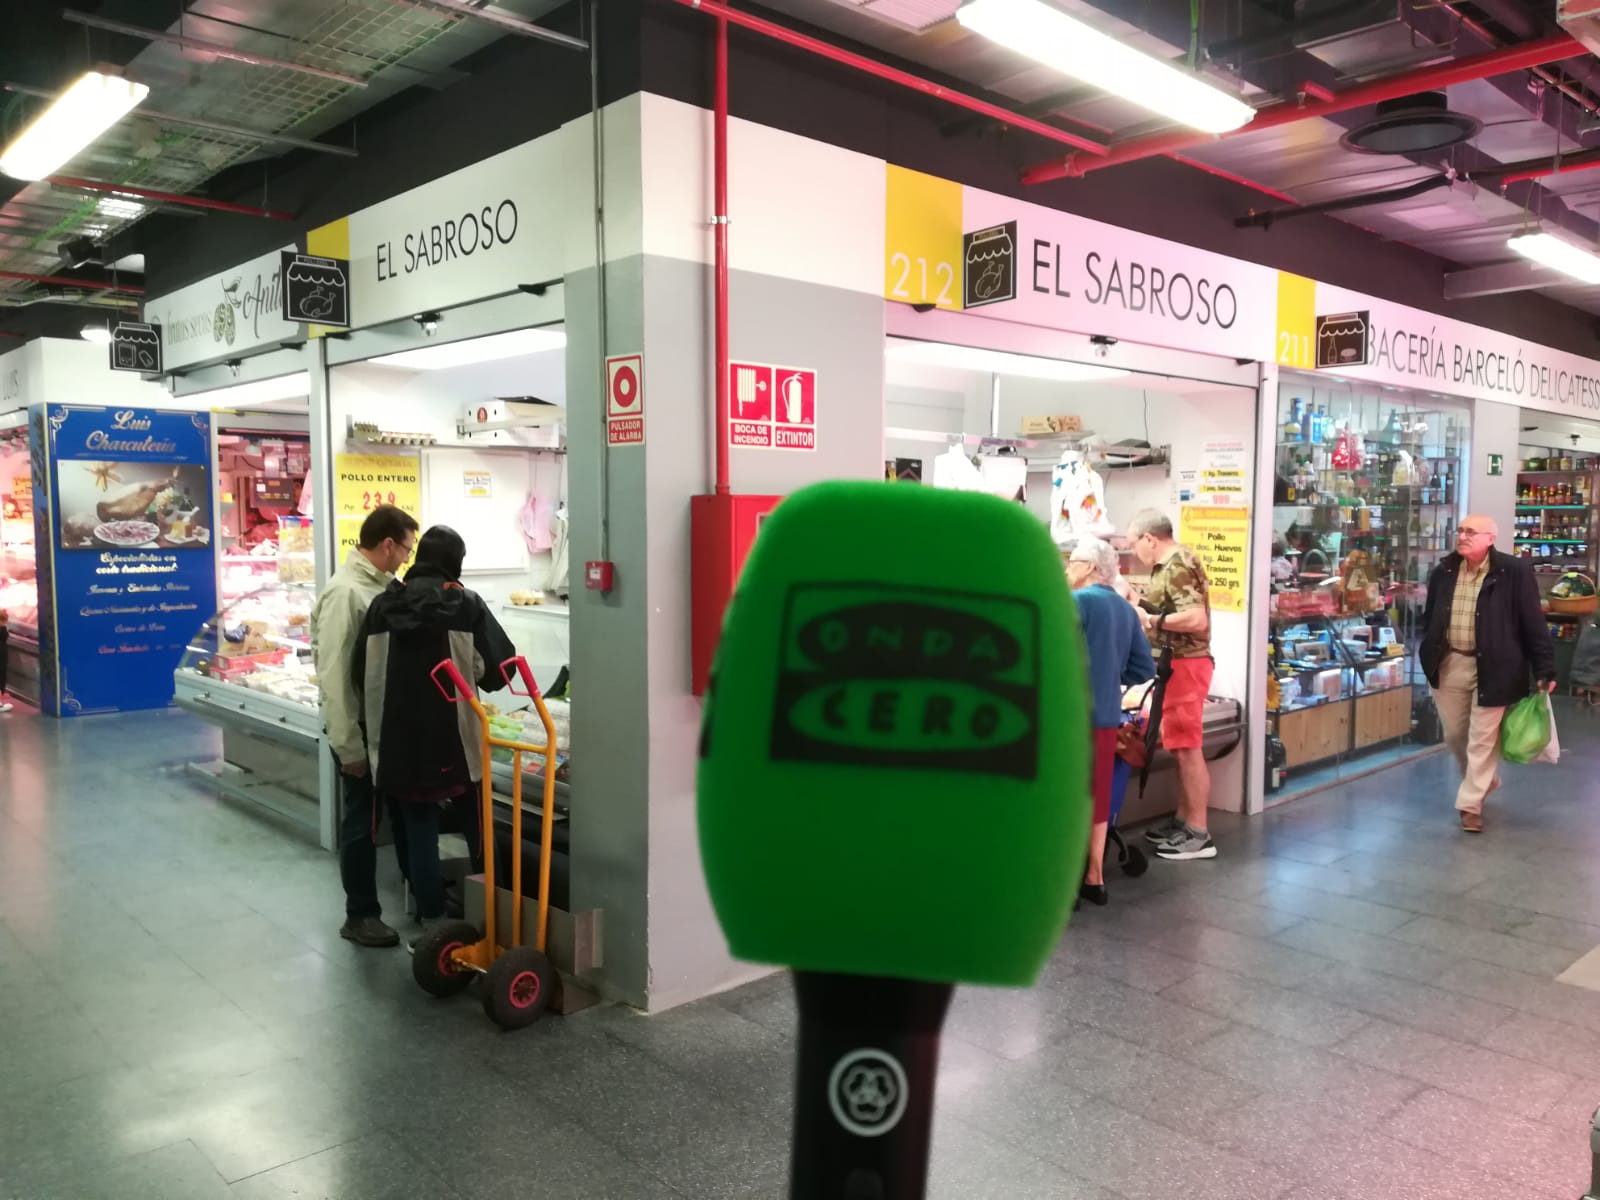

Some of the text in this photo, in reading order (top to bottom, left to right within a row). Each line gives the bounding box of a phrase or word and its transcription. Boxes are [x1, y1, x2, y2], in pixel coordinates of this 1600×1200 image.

[376, 198, 519, 282] EL SABROSO
[889, 252, 954, 306] 212
[1032, 239, 1238, 330] EL SABROSO
[1278, 330, 1310, 366] 211
[1453, 343, 1525, 396] BARCELÓ
[110, 410, 152, 430] Luis
[610, 420, 641, 431] PULSADOR
[610, 431, 642, 441] DE ALARMA
[734, 423, 768, 435] BOCA DE
[733, 434, 769, 445] INCENDIO
[776, 430, 814, 447] EXTINTOR
[341, 473, 416, 483] POLLO ENTERO
[1207, 533, 1226, 541] Pollo
[1214, 544, 1242, 552] Huevos
[1205, 564, 1238, 573] Traseros
[1214, 577, 1228, 587] 250
[1228, 580, 1240, 590] grs
[819, 619, 1000, 660] ONDA
[820, 686, 1002, 740] CERO
